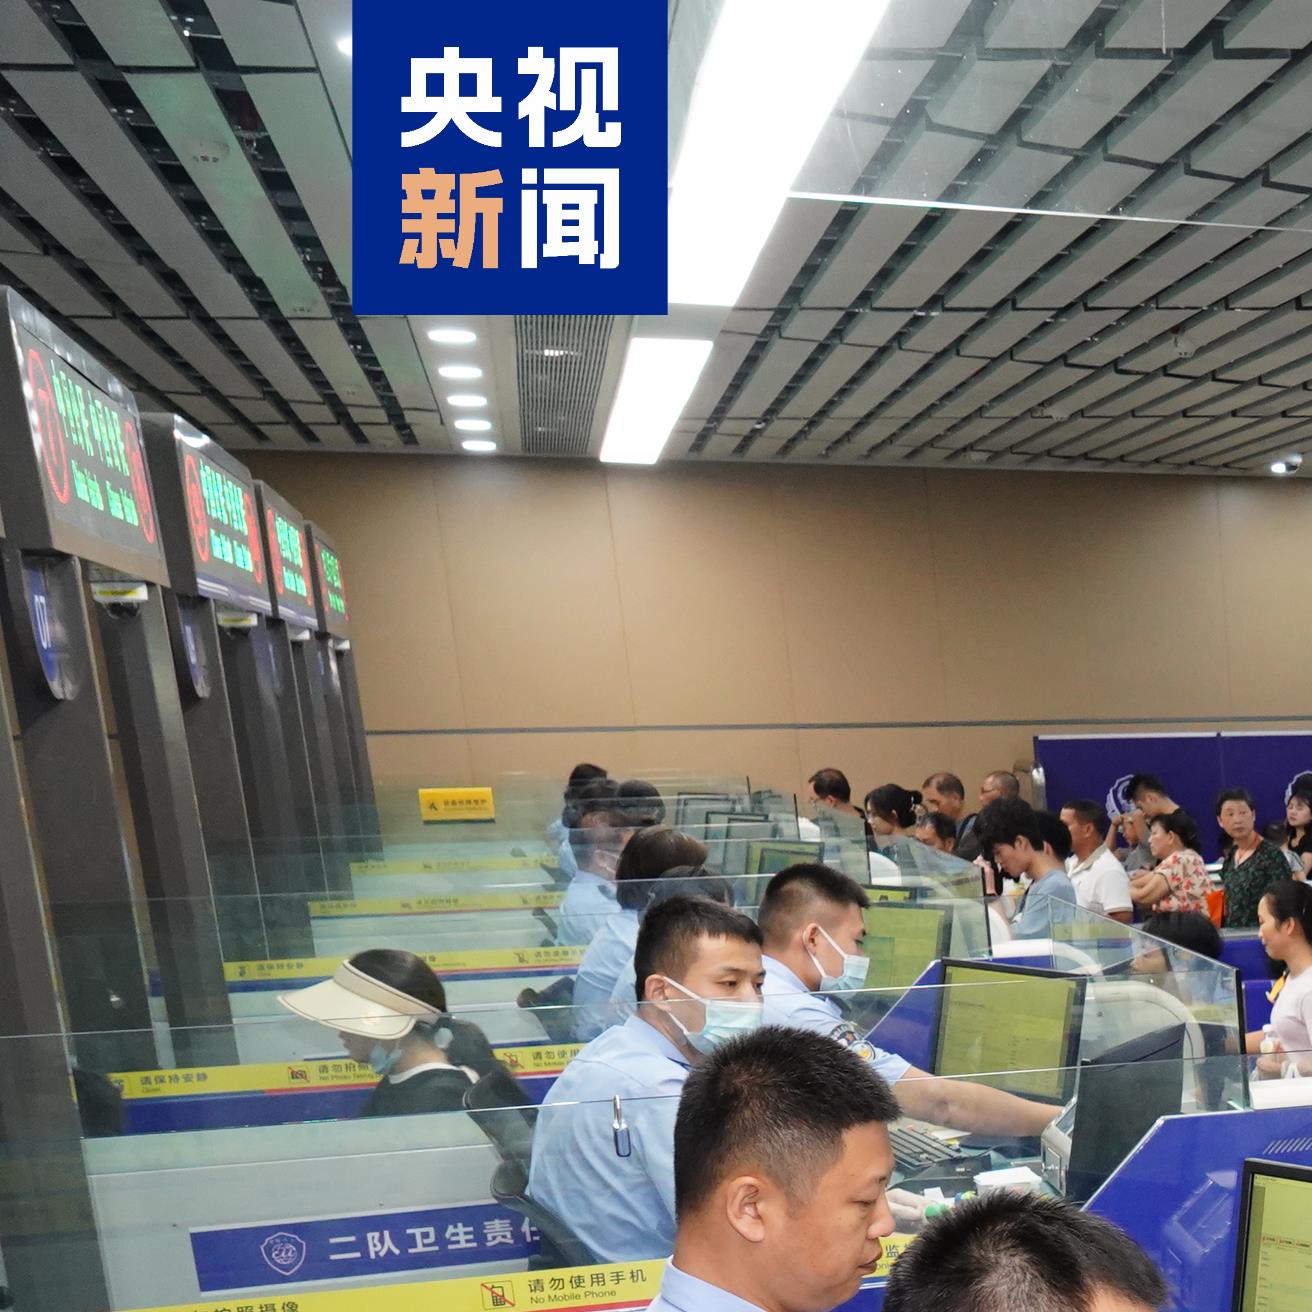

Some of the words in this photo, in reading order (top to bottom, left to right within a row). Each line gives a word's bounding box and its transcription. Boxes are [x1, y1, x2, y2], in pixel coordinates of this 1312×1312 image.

[527, 1268, 648, 1294] 请勿使用手机
[530, 1295, 546, 1305] No
[547, 1292, 582, 1303] Mobile
[583, 1288, 617, 1300] Phone
